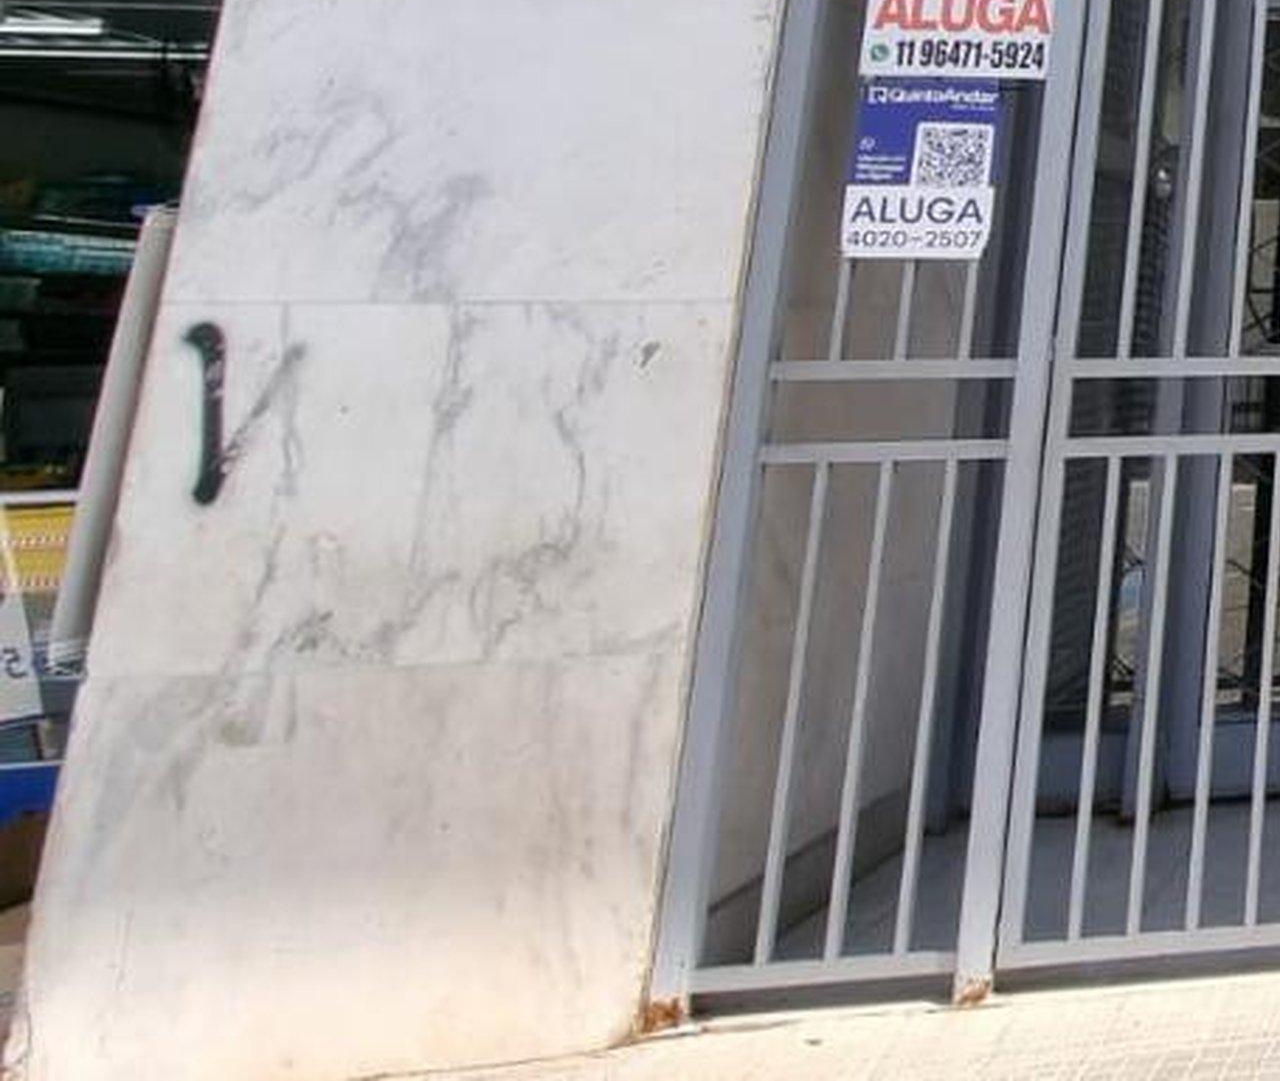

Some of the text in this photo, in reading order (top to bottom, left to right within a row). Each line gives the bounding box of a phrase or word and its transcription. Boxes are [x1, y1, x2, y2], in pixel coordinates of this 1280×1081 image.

[896, 38, 1045, 71] 11 96471-5924
[851, 195, 983, 224] ALUGA
[846, 229, 983, 249] 4020-2507
